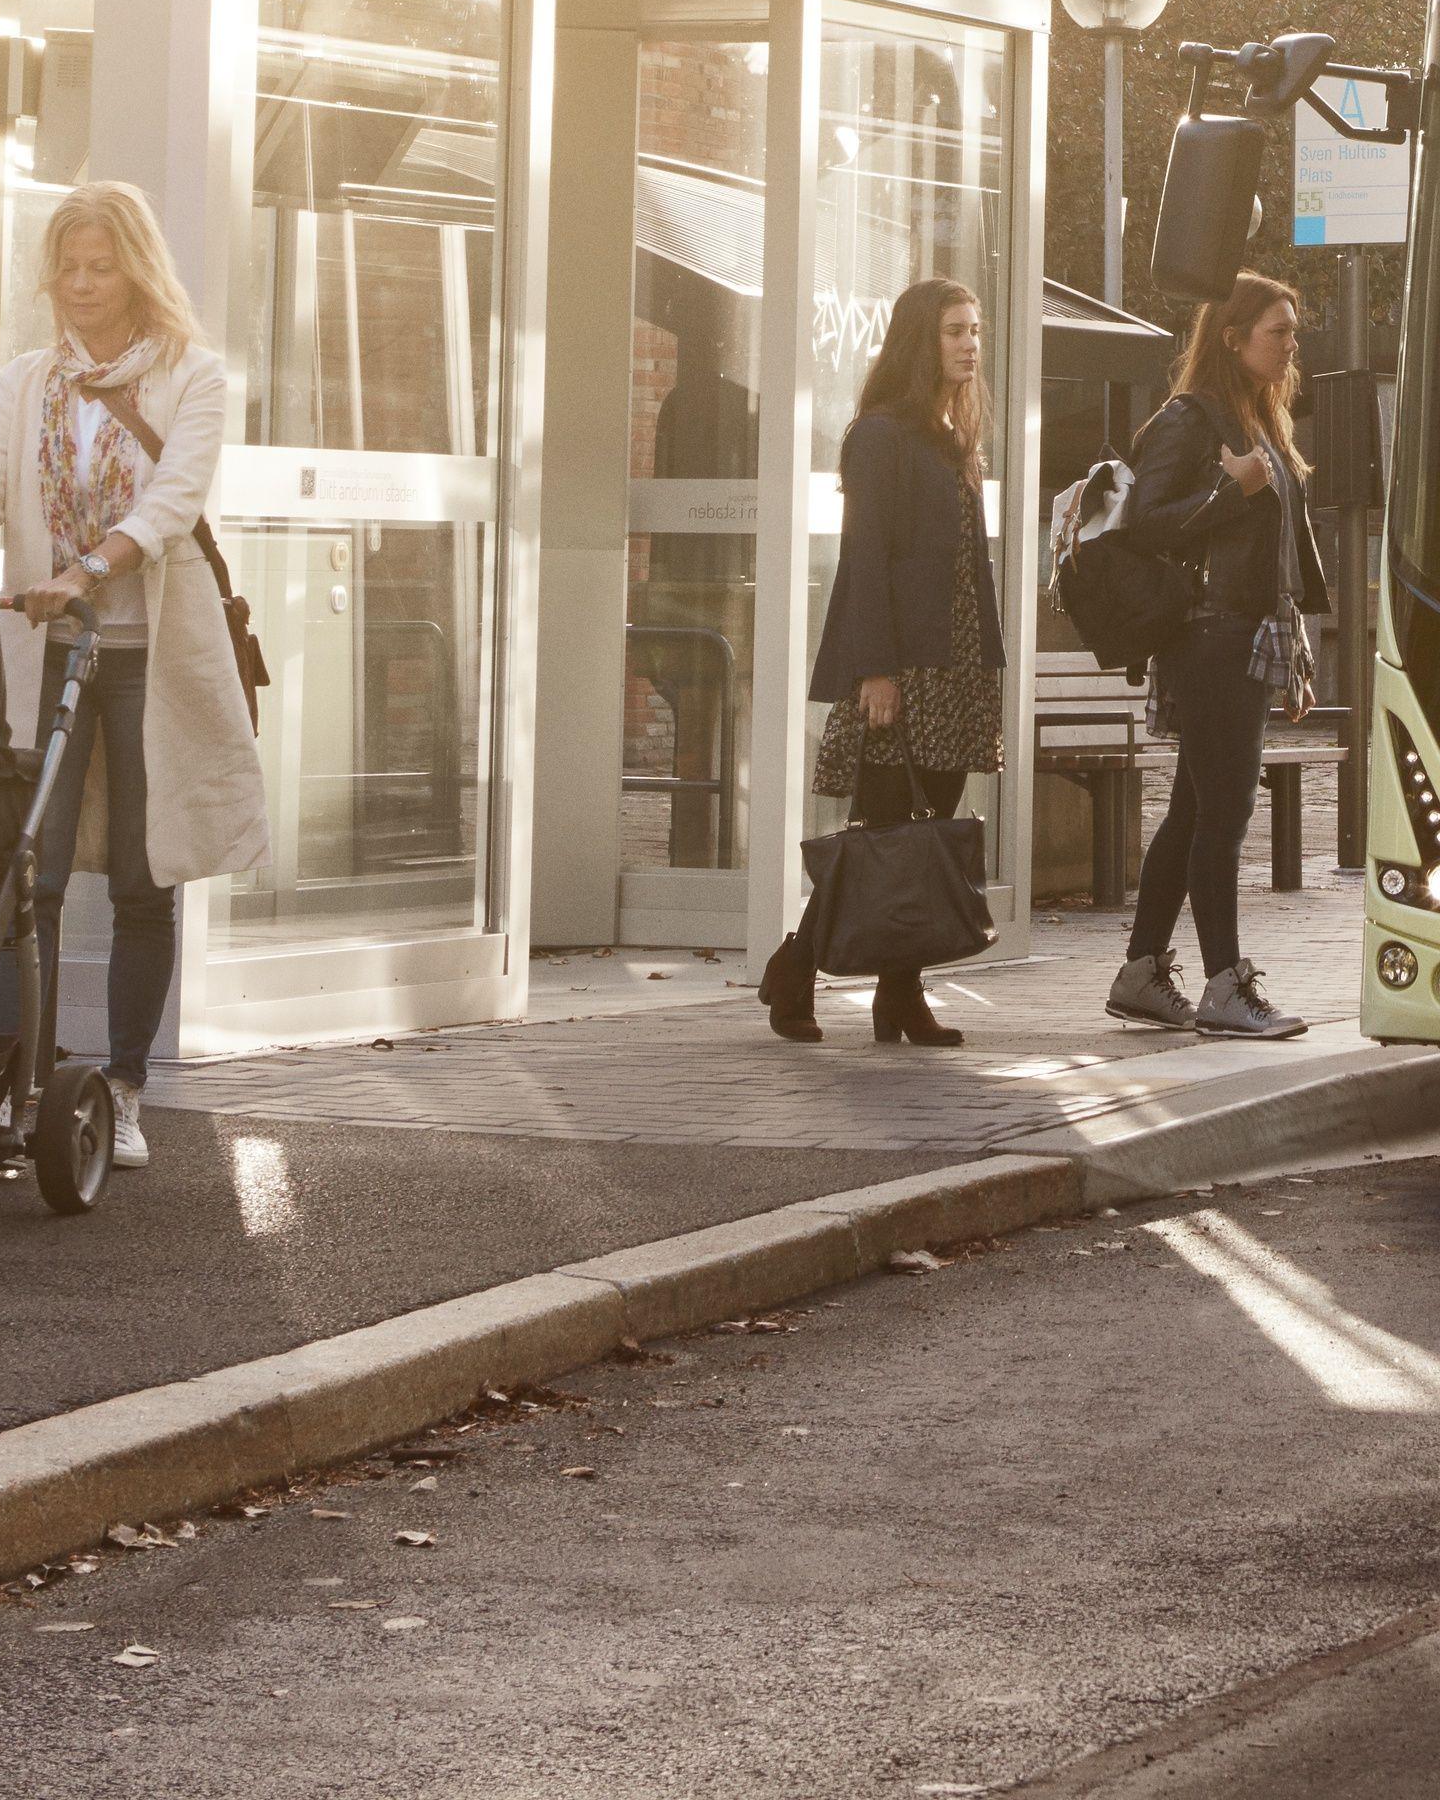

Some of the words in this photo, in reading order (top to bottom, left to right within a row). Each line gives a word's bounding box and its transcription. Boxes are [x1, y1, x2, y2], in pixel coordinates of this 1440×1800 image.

[1340, 78, 1365, 128] A
[1300, 145, 1332, 161] Sven
[1339, 143, 1387, 160] Hultins
[1299, 167, 1333, 183] Plats
[1297, 191, 1324, 212] 55
